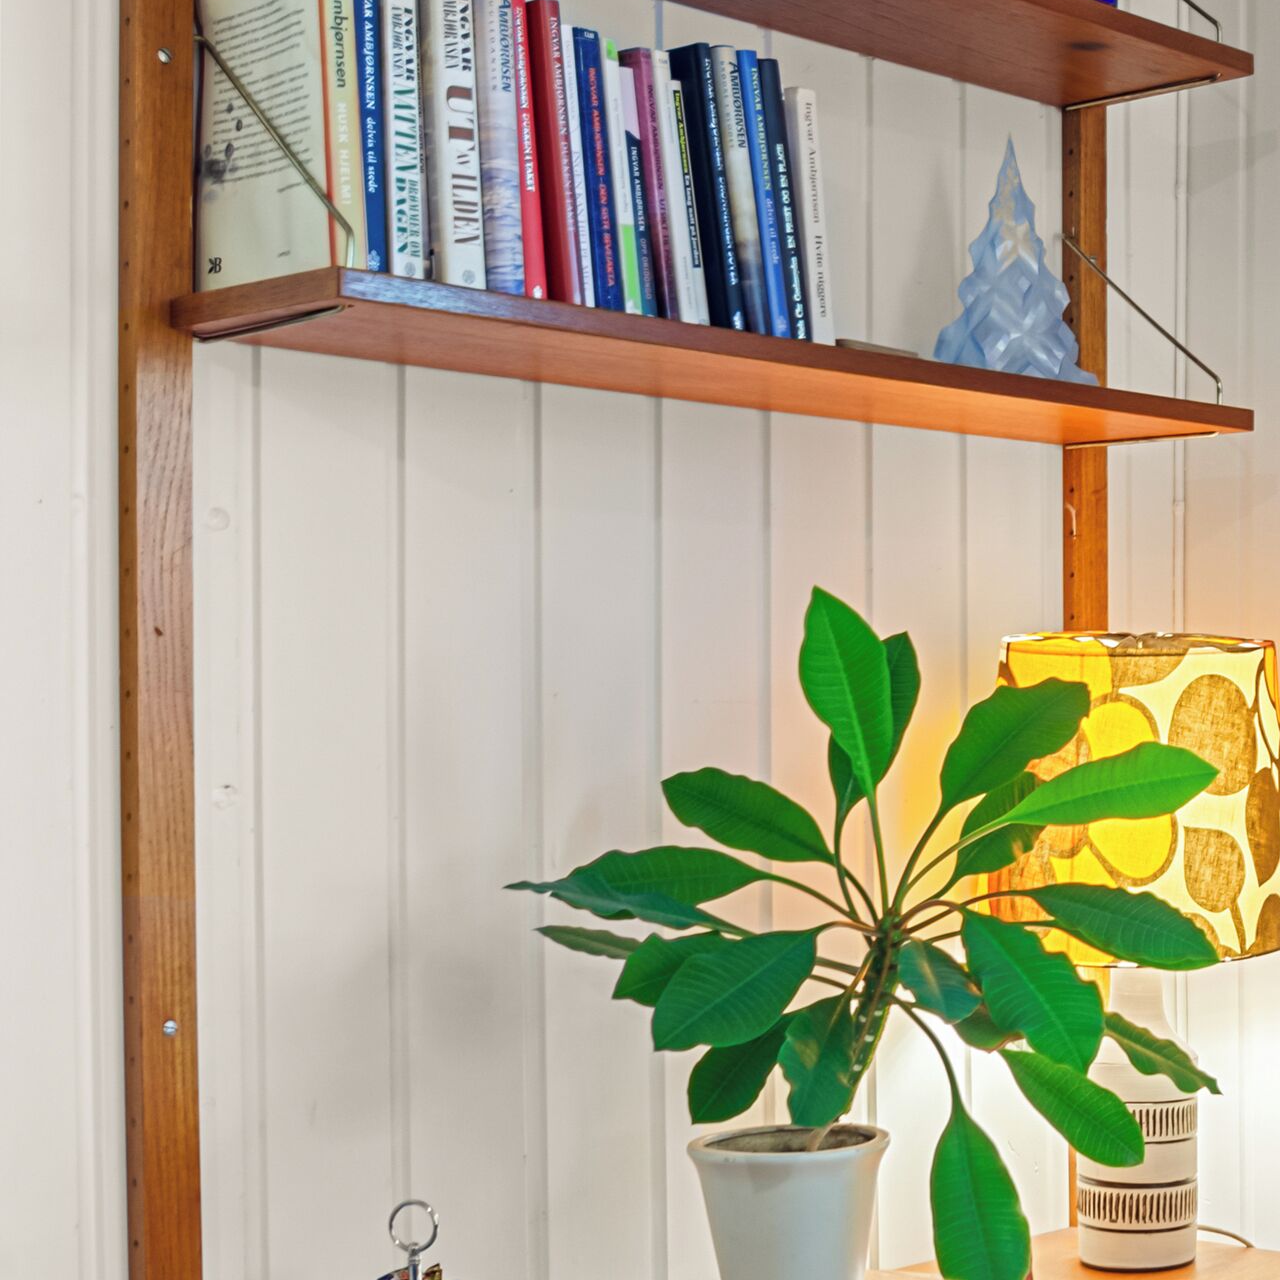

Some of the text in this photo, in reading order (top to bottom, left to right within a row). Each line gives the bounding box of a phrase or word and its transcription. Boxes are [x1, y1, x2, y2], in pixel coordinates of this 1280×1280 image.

[392, 6, 404, 79] AMBJØRNSEN
[404, 7, 414, 81] INGVAR
[550, 17, 561, 58] INGVAR
[364, 20, 376, 110] AMBJØRNSEN
[588, 68, 598, 106] INGVAR
[447, 85, 475, 151] UT
[554, 61, 567, 135] AMBJØRNSEN
[729, 62, 746, 148] AMBJØRNSEN
[337, 102, 348, 143] HUSK
[367, 117, 376, 147] delvis
[393, 82, 418, 175] NATTEN
[805, 102, 814, 143] Ingvar
[367, 151, 377, 163] til
[631, 147, 639, 176] INGVAR
[752, 68, 762, 111] INGVAR
[757, 114, 772, 190] AMBJØRNSEN
[766, 198, 775, 225] delvis
[368, 166, 378, 193] stede
[526, 161, 535, 192] TAKET
[779, 174, 789, 188] EN
[781, 190, 790, 204] OG
[809, 147, 821, 223] Ambjørnsen
[396, 177, 408, 253] DAGEN
[408, 179, 421, 258] DRØMMER OM
[452, 173, 480, 246] ILDEN
[634, 179, 645, 231] AMBJØRNSEN
[786, 235, 796, 248] EN
[814, 235, 824, 267] Hvite
